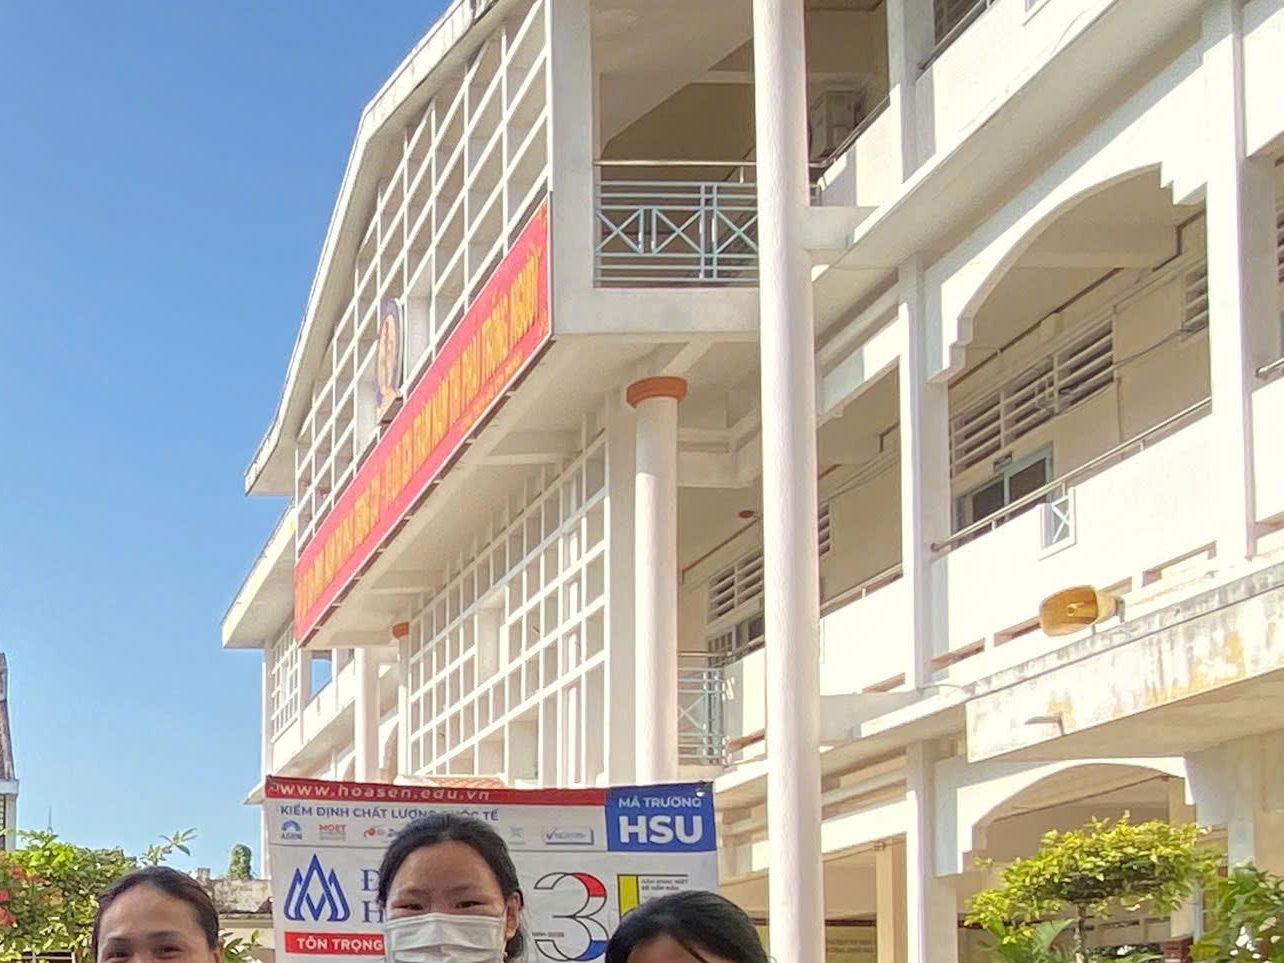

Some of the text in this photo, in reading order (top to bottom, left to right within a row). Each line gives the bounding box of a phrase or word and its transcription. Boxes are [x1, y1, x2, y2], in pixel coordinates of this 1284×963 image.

[280, 783, 490, 801] www.hoasen.edu.vn
[316, 806, 350, 820] ĐỊNH
[353, 805, 388, 819] CHẤT
[619, 815, 704, 844] HSU
[296, 936, 384, 953] TÔN TRỌNG
